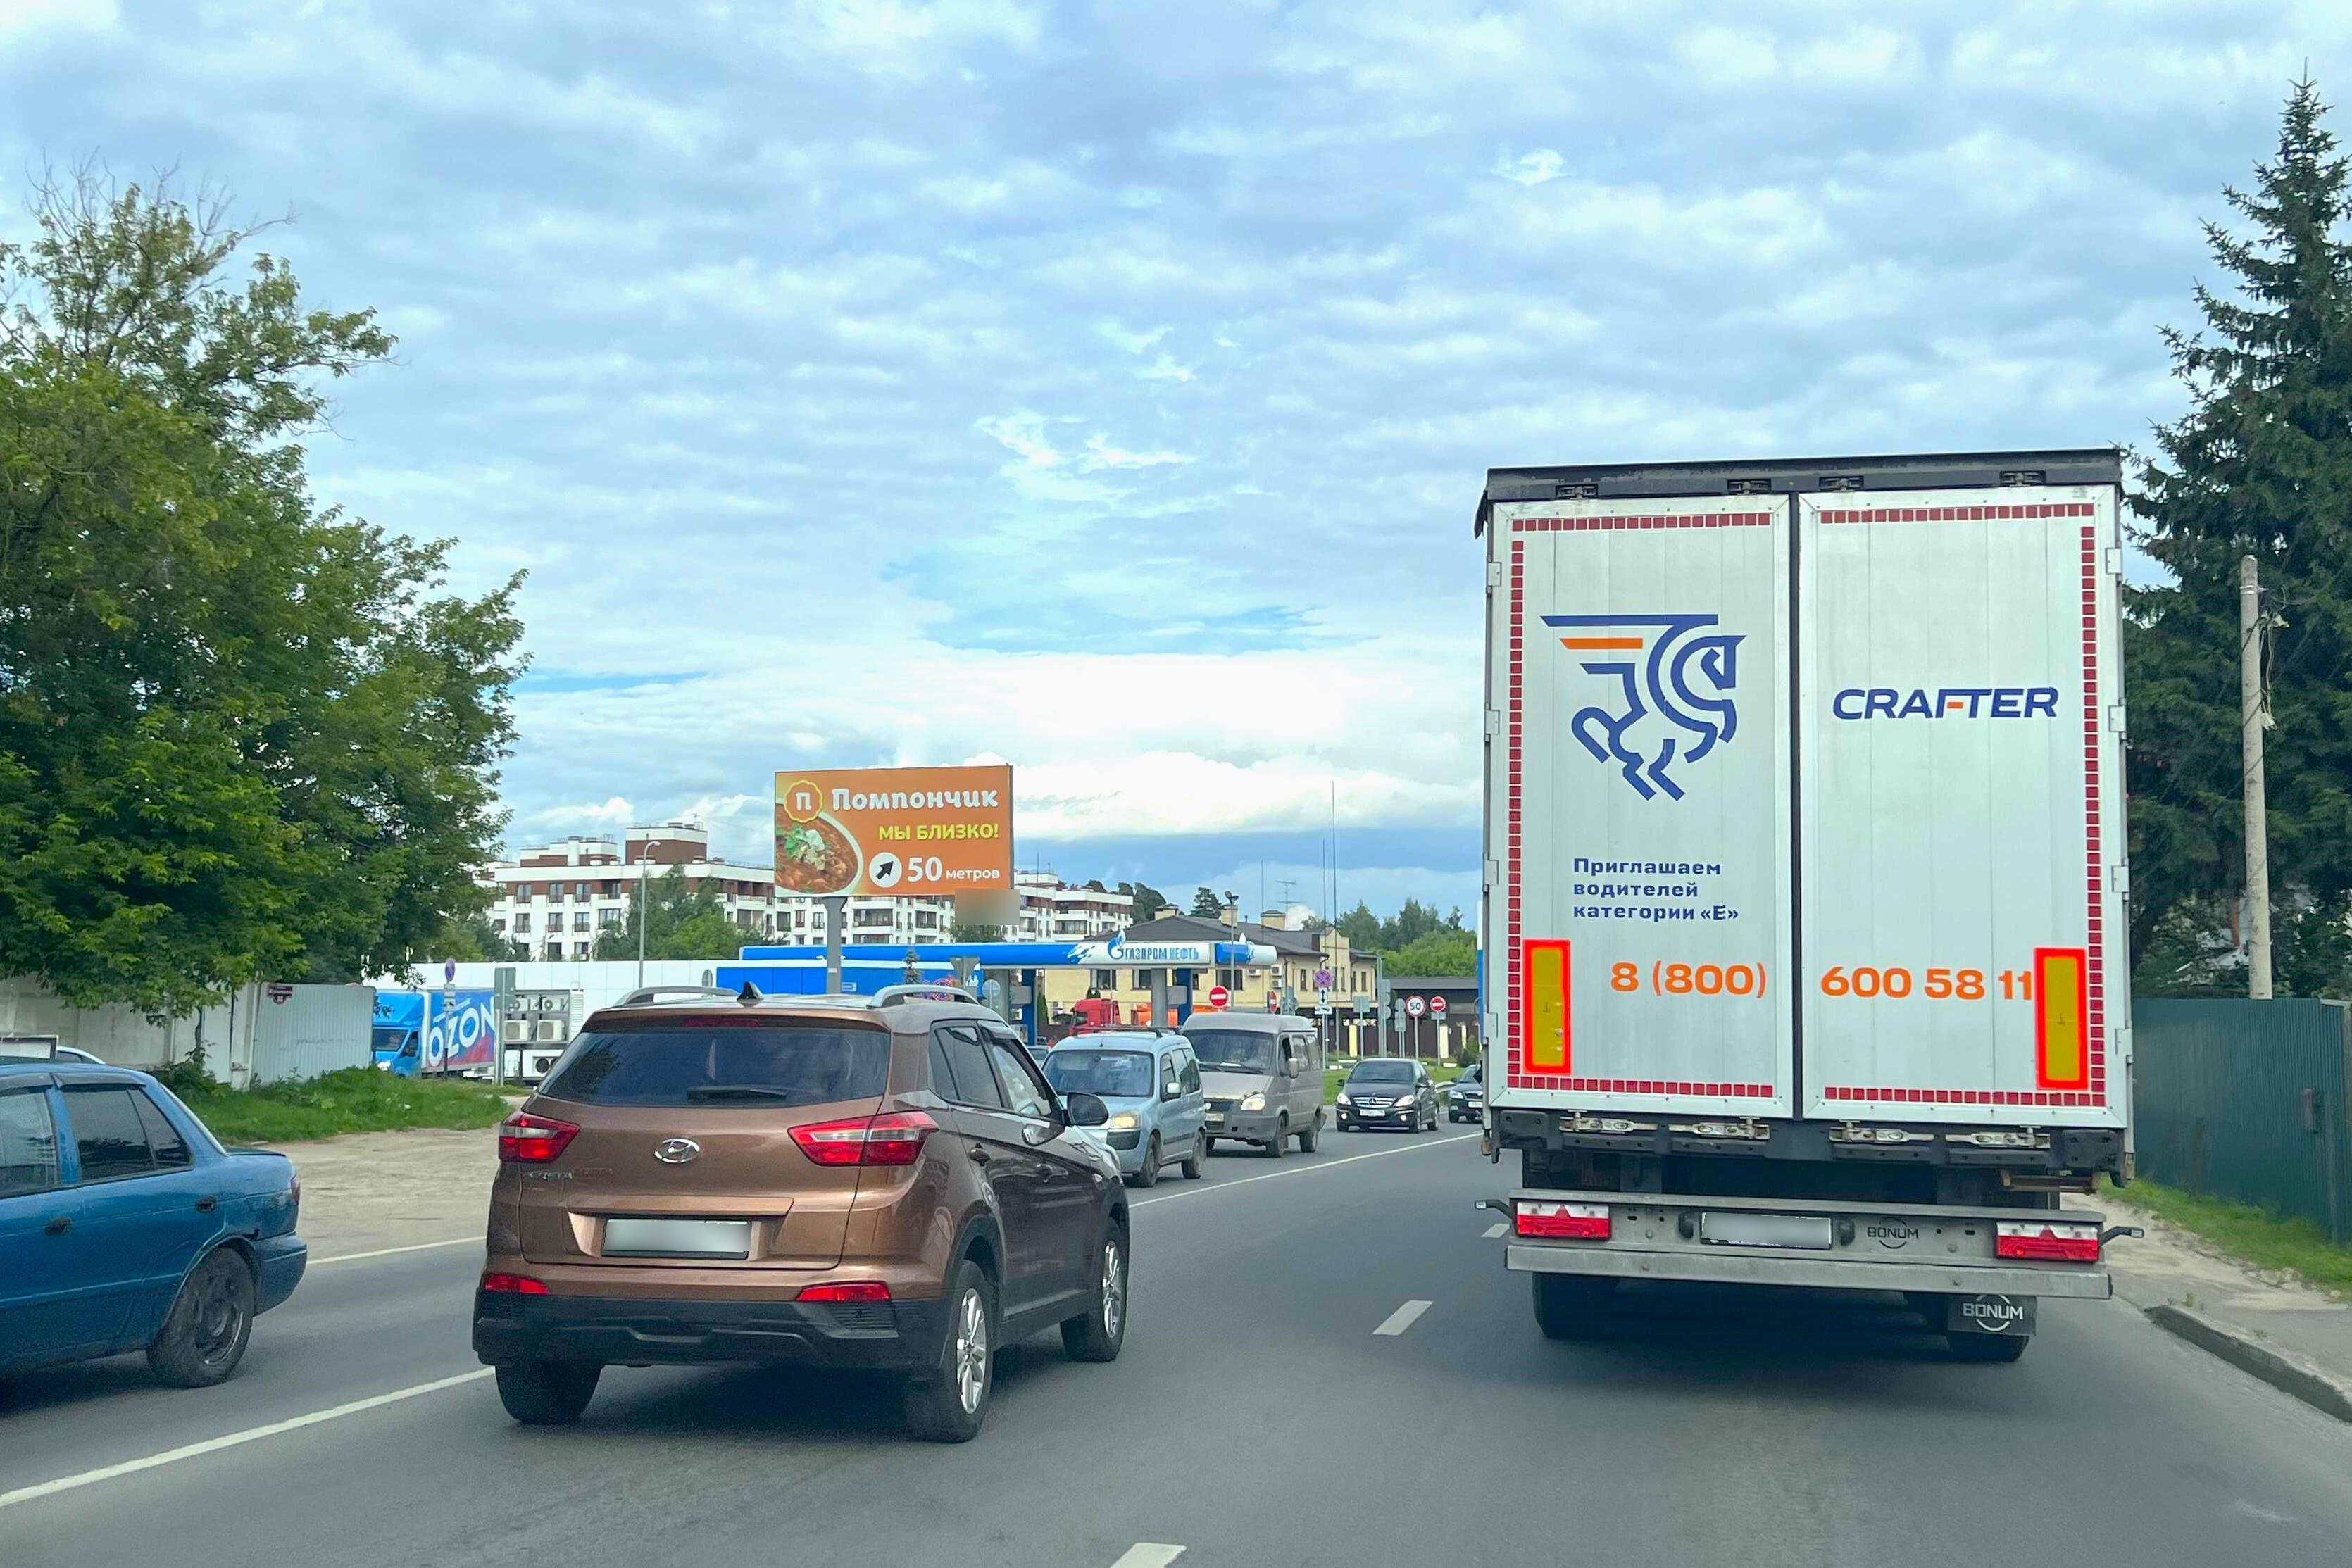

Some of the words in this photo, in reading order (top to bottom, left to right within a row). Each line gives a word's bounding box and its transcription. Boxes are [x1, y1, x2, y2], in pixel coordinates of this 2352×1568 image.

[1832, 687, 2059, 720] CRAFTER
[831, 789, 999, 810] Помпончик
[879, 825, 911, 841] МЫ
[917, 824, 999, 840] БЛИЗКО!
[907, 857, 943, 882] 50
[946, 868, 1000, 881] метров
[1574, 858, 1721, 876] Приглашаем
[1574, 882, 1698, 898] водителей
[1573, 905, 1694, 922] категории
[1126, 948, 1167, 960] ГАЗПРОМ
[1170, 947, 1199, 959] НЕФТЬ
[1611, 962, 1639, 992] 8
[1652, 960, 1767, 998] (800)
[1820, 967, 1912, 998] 600
[1924, 969, 1984, 1000] 58
[1998, 970, 2032, 1000] 11
[1410, 1002, 1421, 1010] 50
[428, 996, 496, 1067] OZON
[1868, 1227, 1919, 1239] BONUM
[1963, 1303, 2023, 1320] BONUM
